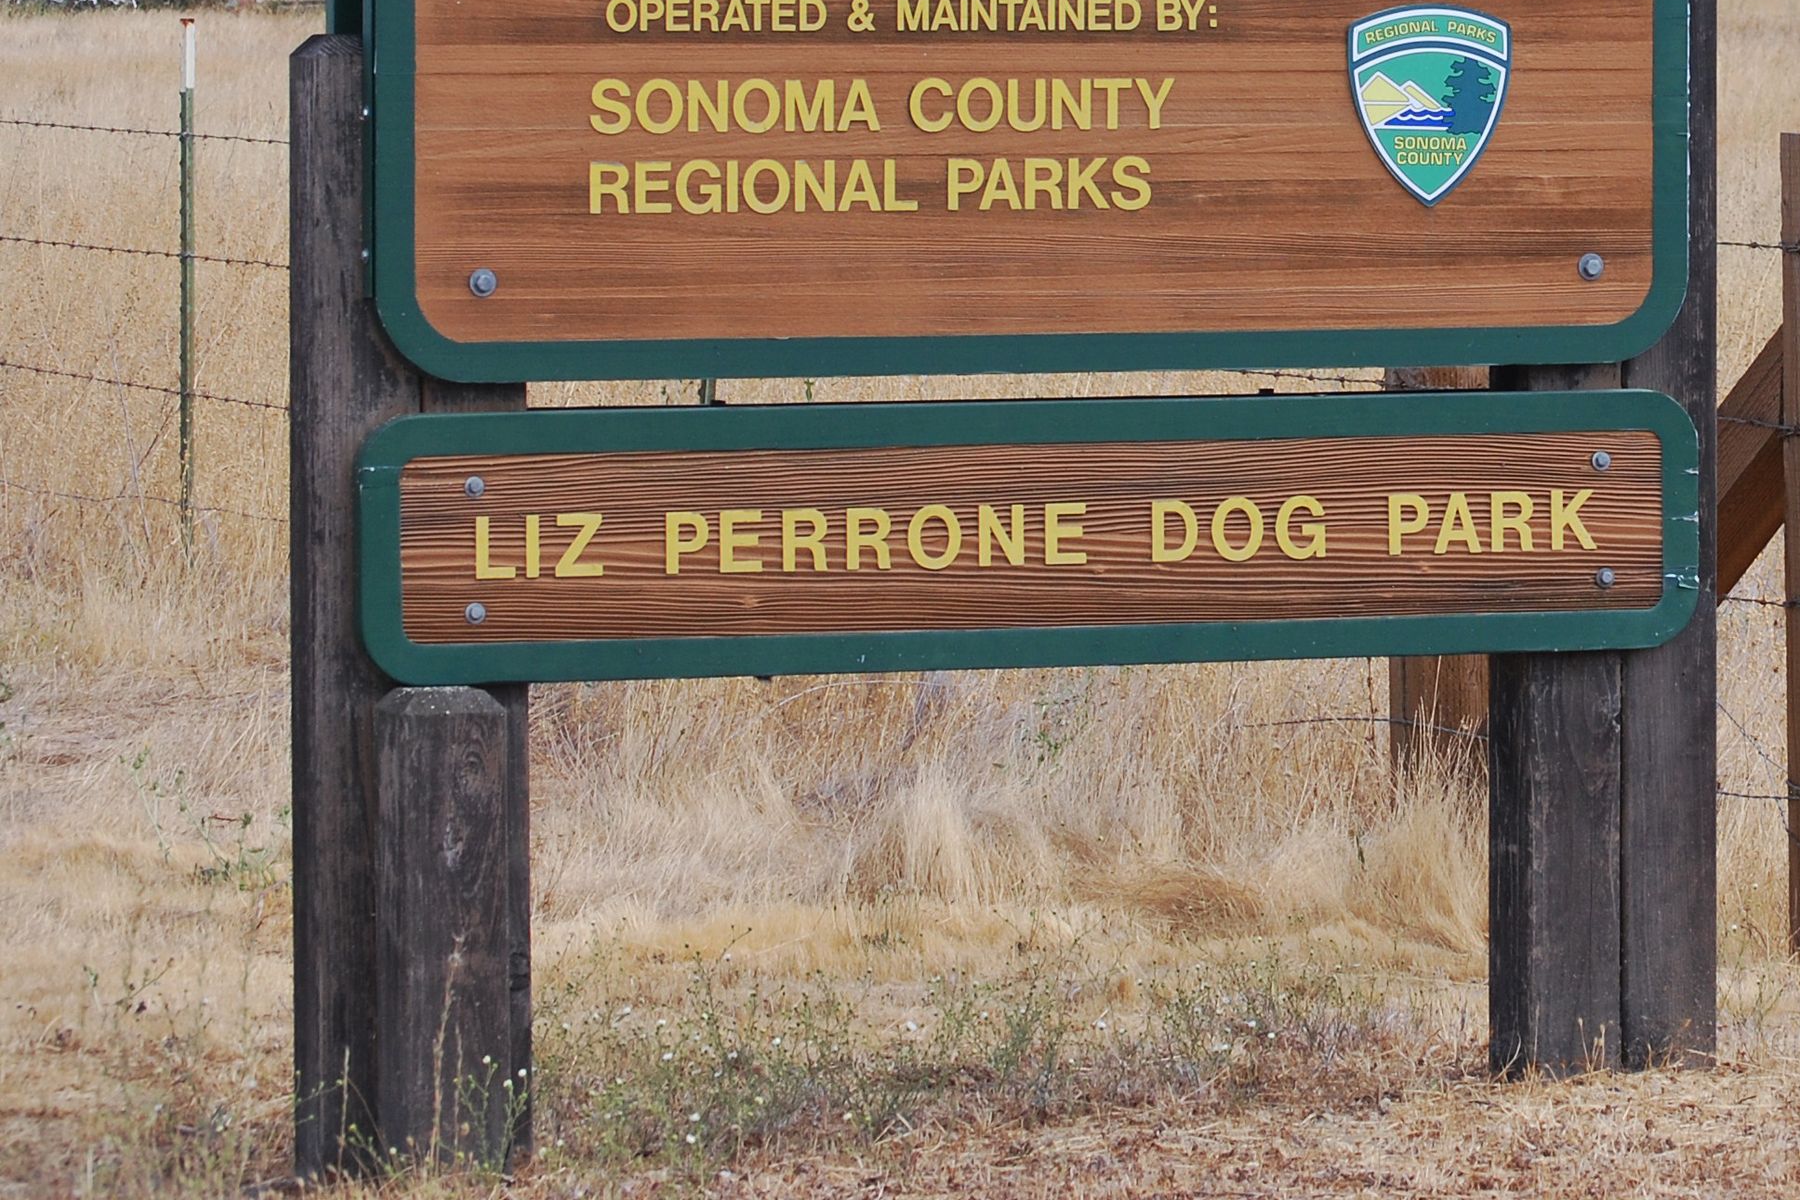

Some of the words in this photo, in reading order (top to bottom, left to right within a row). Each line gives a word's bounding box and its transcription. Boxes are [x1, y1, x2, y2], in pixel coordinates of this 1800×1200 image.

[1365, 20, 1438, 44] REGIONAL
[1447, 21, 1496, 44] PARKS
[589, 78, 881, 135] SONOMA
[909, 76, 1176, 133] COUNTY
[1394, 136, 1467, 150] SONOMA
[1397, 152, 1463, 165] COUNTY
[588, 158, 919, 215] REGIONAL
[947, 155, 1152, 211] PARKS
[475, 511, 605, 580] LIZ
[665, 501, 1089, 575] PERRONE
[1151, 494, 1328, 563] DOG
[1387, 488, 1598, 556] PARK
